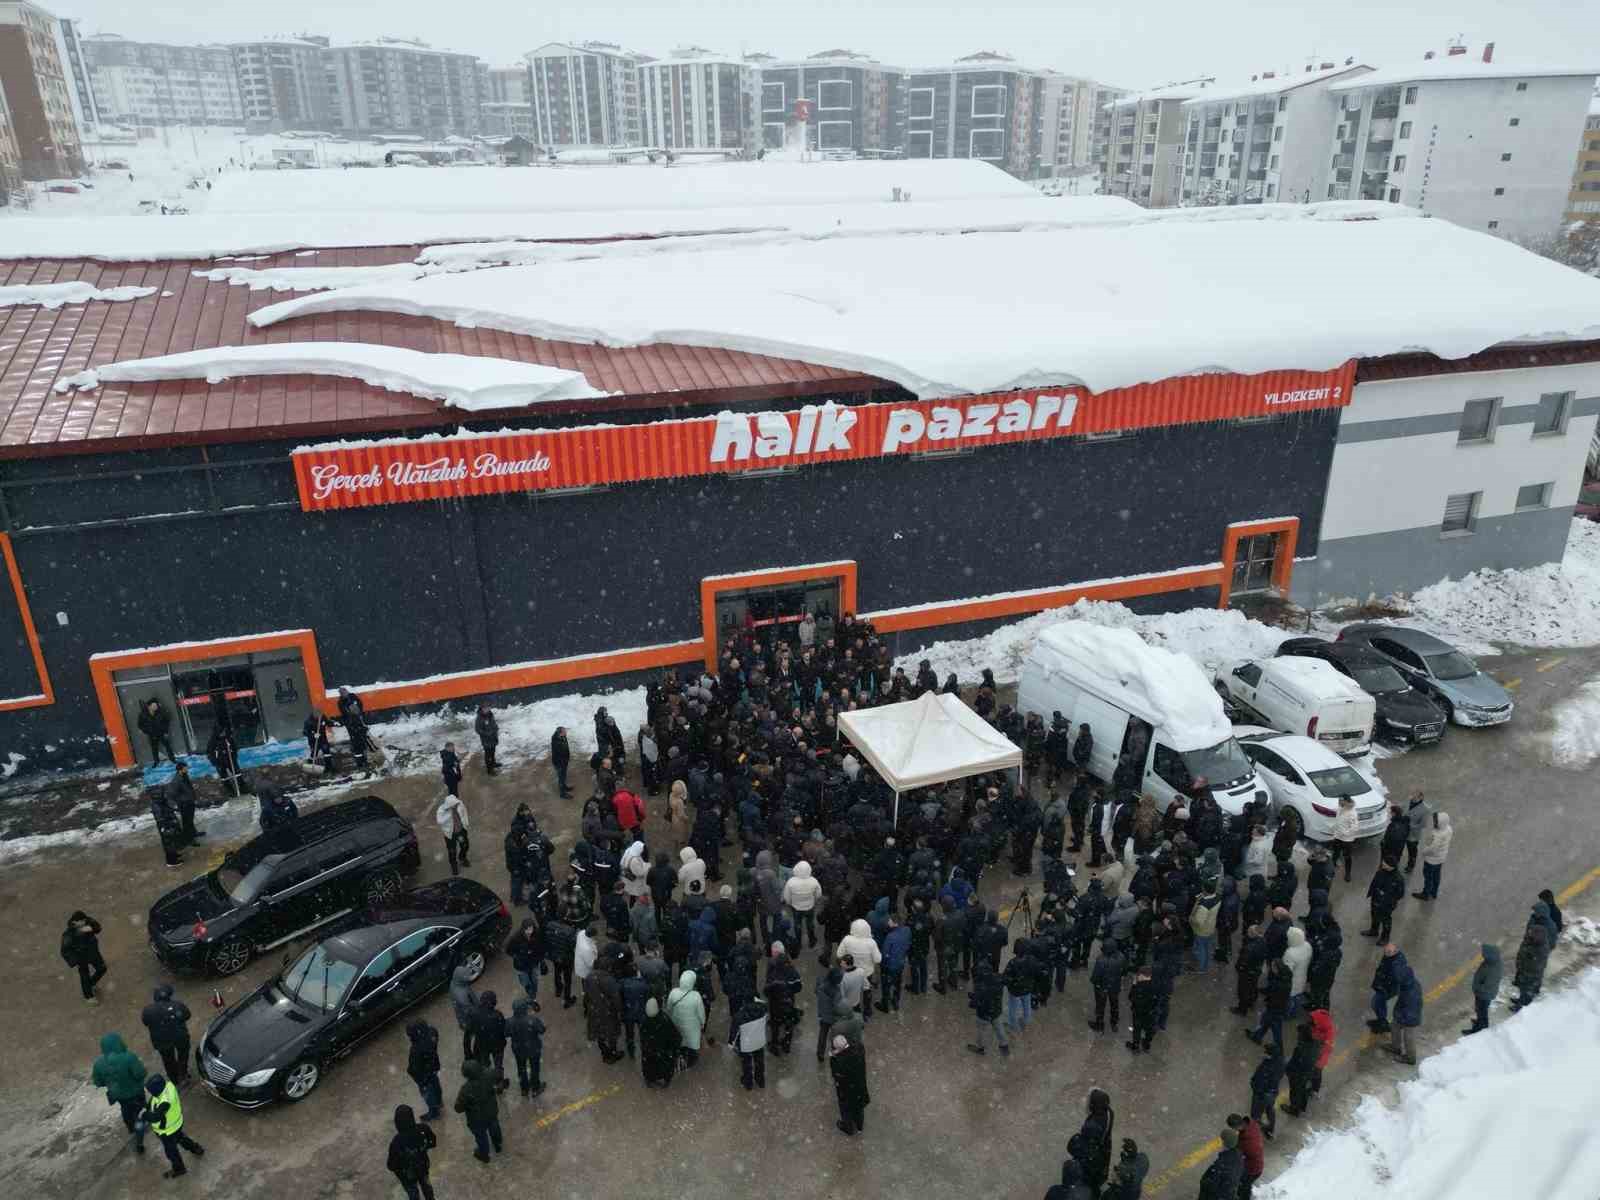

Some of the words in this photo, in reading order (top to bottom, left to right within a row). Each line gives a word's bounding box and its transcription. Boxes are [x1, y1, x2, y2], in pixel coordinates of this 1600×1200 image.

[1264, 388, 1331, 405] YILDIZKENT
[1333, 386, 1342, 398] 2
[710, 405, 858, 463] halk
[881, 395, 1079, 453] pazarı
[311, 464, 383, 499] Gerçek
[387, 457, 468, 486] Ucuzluk
[471, 450, 551, 478] Burada
